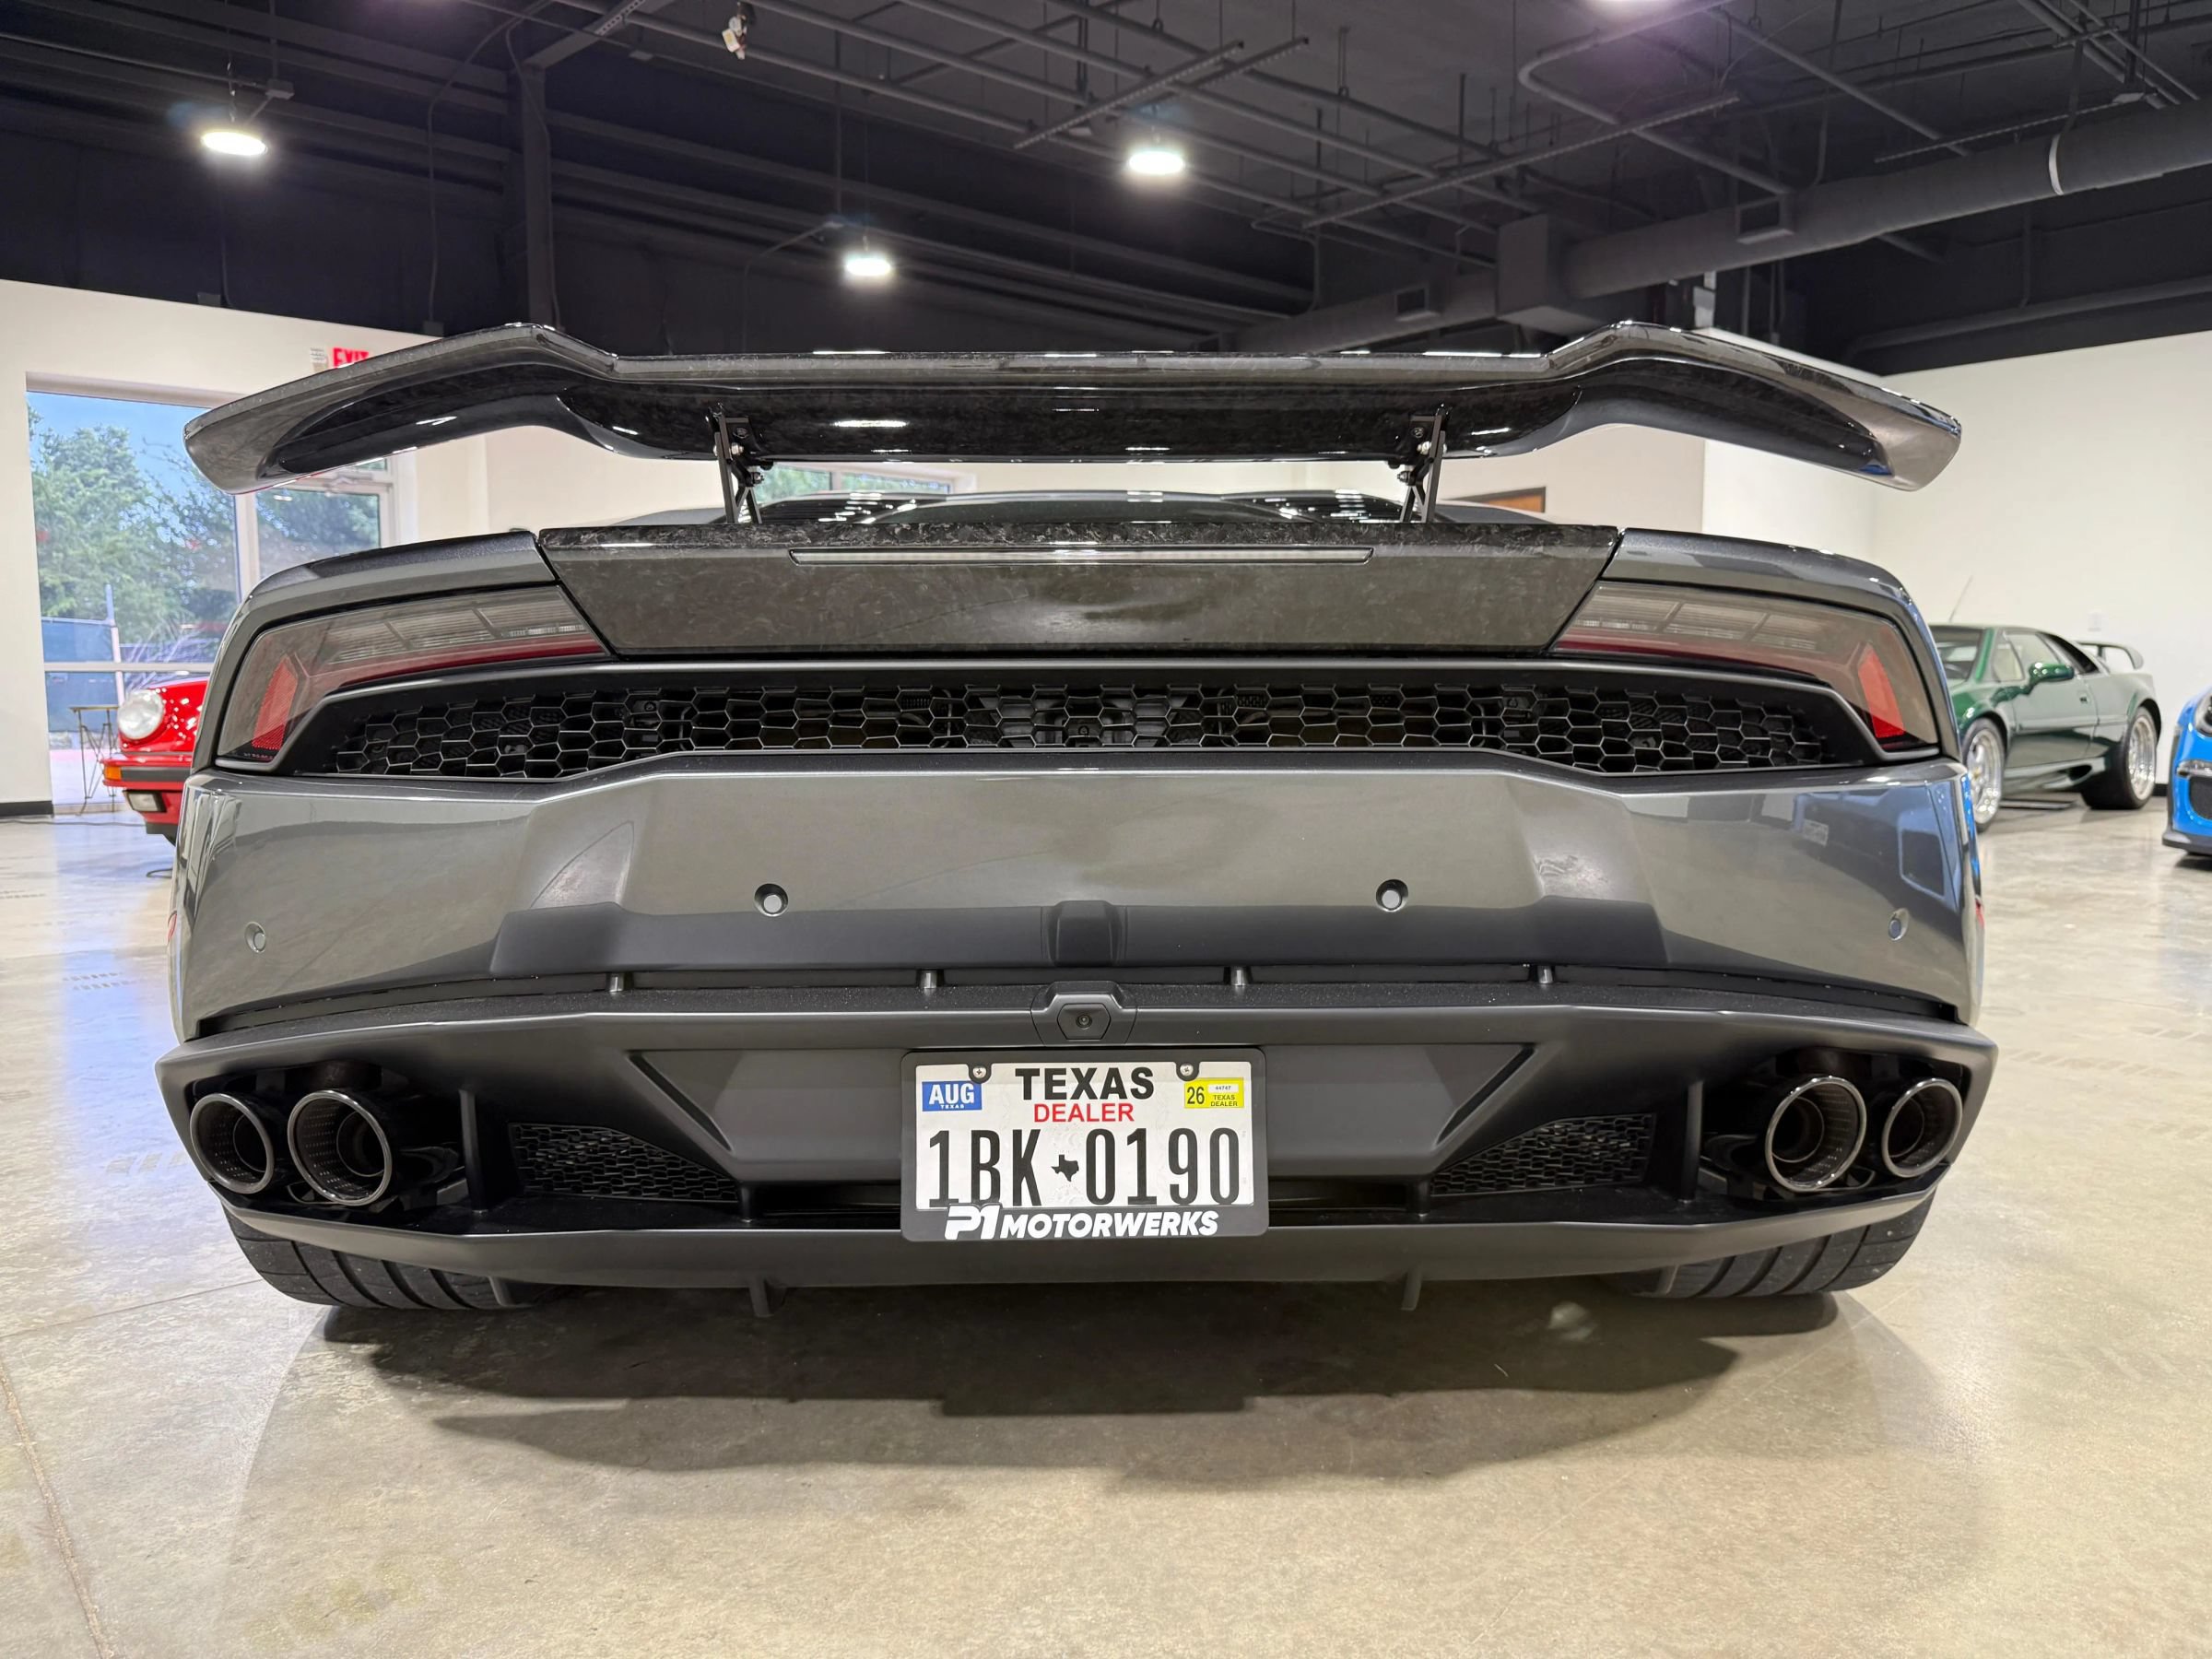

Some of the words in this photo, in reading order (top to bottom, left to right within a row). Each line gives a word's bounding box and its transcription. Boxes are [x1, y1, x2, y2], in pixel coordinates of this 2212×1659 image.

[929, 1083, 975, 1104] AUG
[1015, 1066, 1155, 1100] TEXAS
[1187, 1086, 1205, 1104] 26
[1033, 1102, 1135, 1123] DEALER
[929, 1129, 1042, 1207] 1BK
[1086, 1127, 1240, 1206] 0190
[944, 1205, 1001, 1241] P1
[1000, 1210, 1219, 1239] MOTORWERKS
